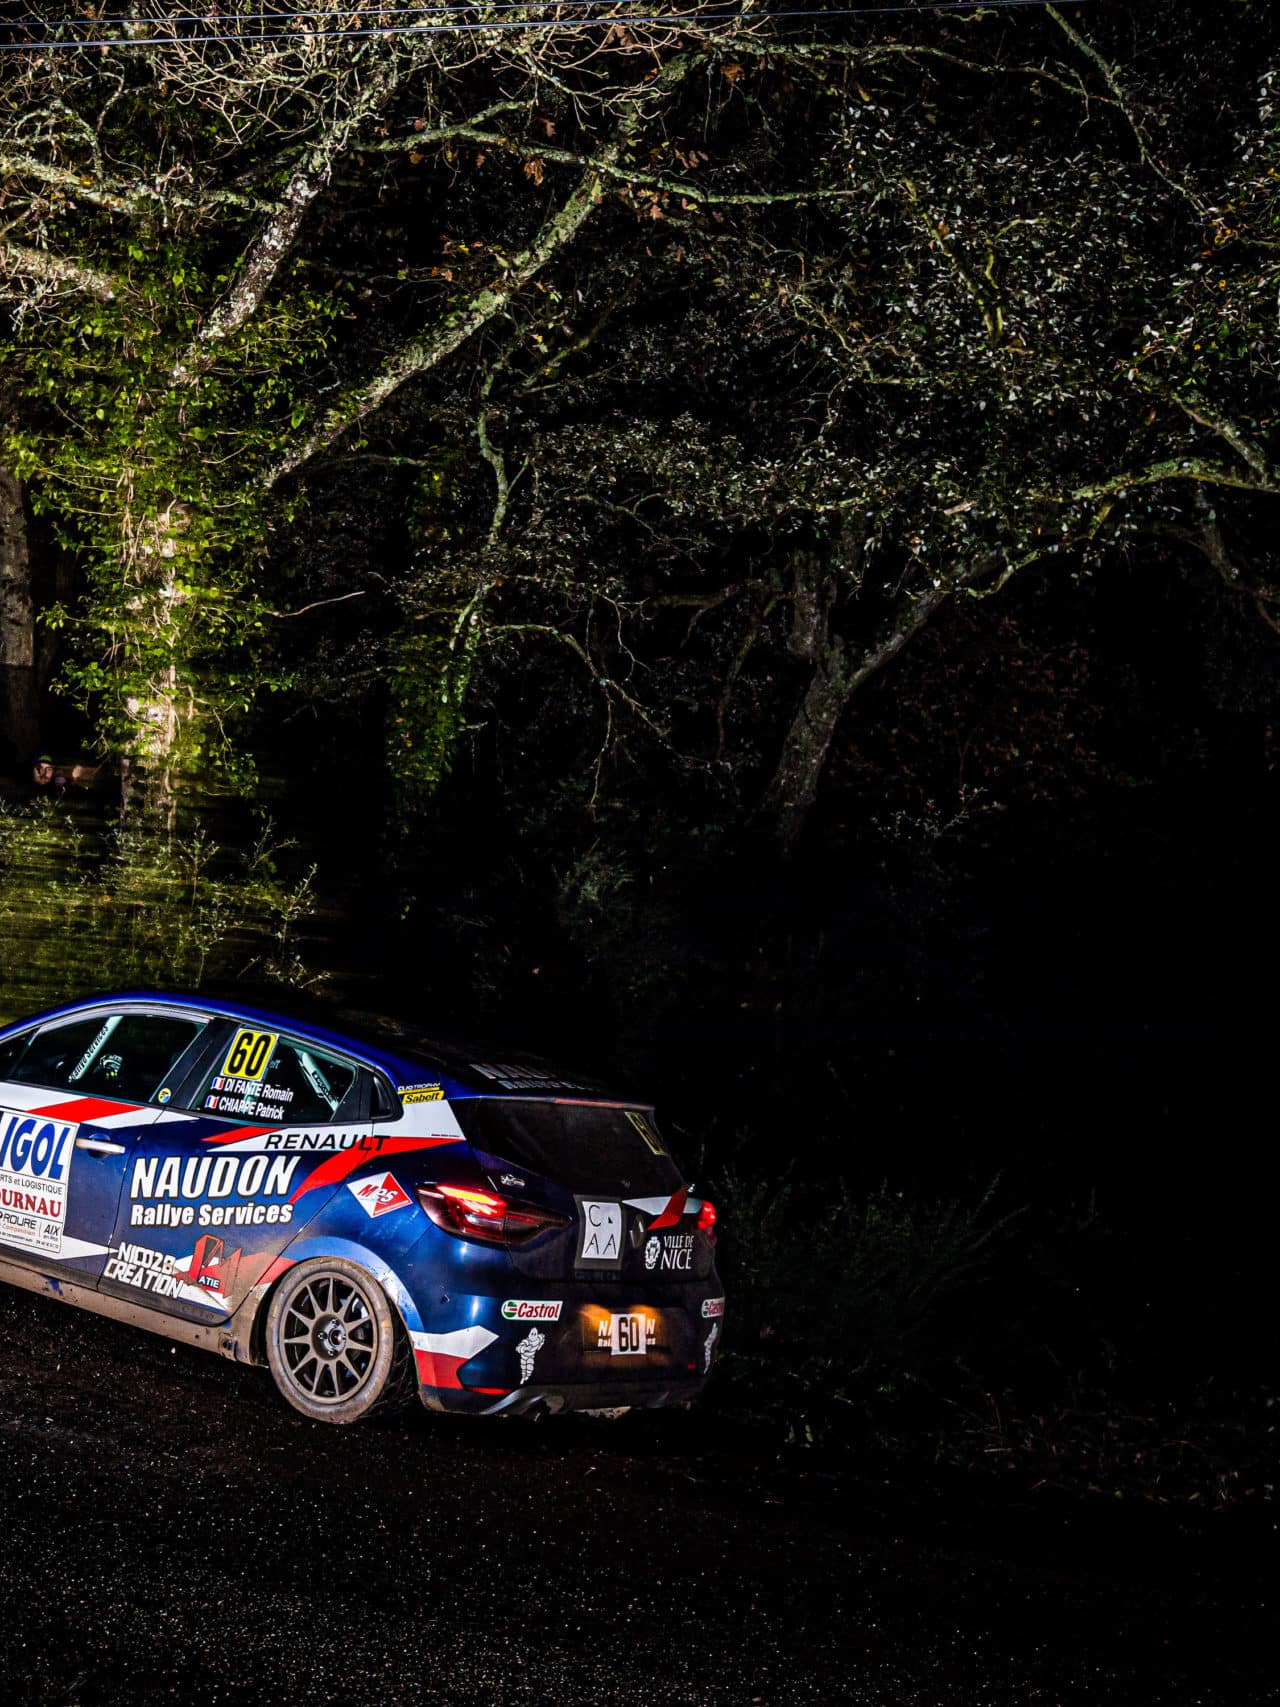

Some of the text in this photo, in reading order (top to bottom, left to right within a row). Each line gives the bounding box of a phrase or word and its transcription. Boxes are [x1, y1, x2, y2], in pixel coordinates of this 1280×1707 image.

[228, 1032, 271, 1077] 60
[224, 1079, 235, 1093] DI
[234, 1080, 262, 1097] FANTE
[262, 1084, 294, 1102] Romain
[404, 1092, 441, 1103] Sabelt
[218, 1097, 285, 1120] CHIAPPE Patrick
[264, 1134, 391, 1151] RENAULT
[14, 1177, 21, 1185] et
[21, 1180, 63, 1196] LOGISTIQUE
[130, 1154, 301, 1199] NAUDON
[3, 1212, 37, 1230] ROURE
[44, 1224, 60, 1237] AIX
[130, 1202, 293, 1226] Rallye Services
[664, 1235, 695, 1249] VILLE DE
[660, 1248, 693, 1270] NICE
[103, 1258, 184, 1299] CREATION
[517, 1302, 560, 1319] Castrol
[619, 1316, 640, 1352] 60
